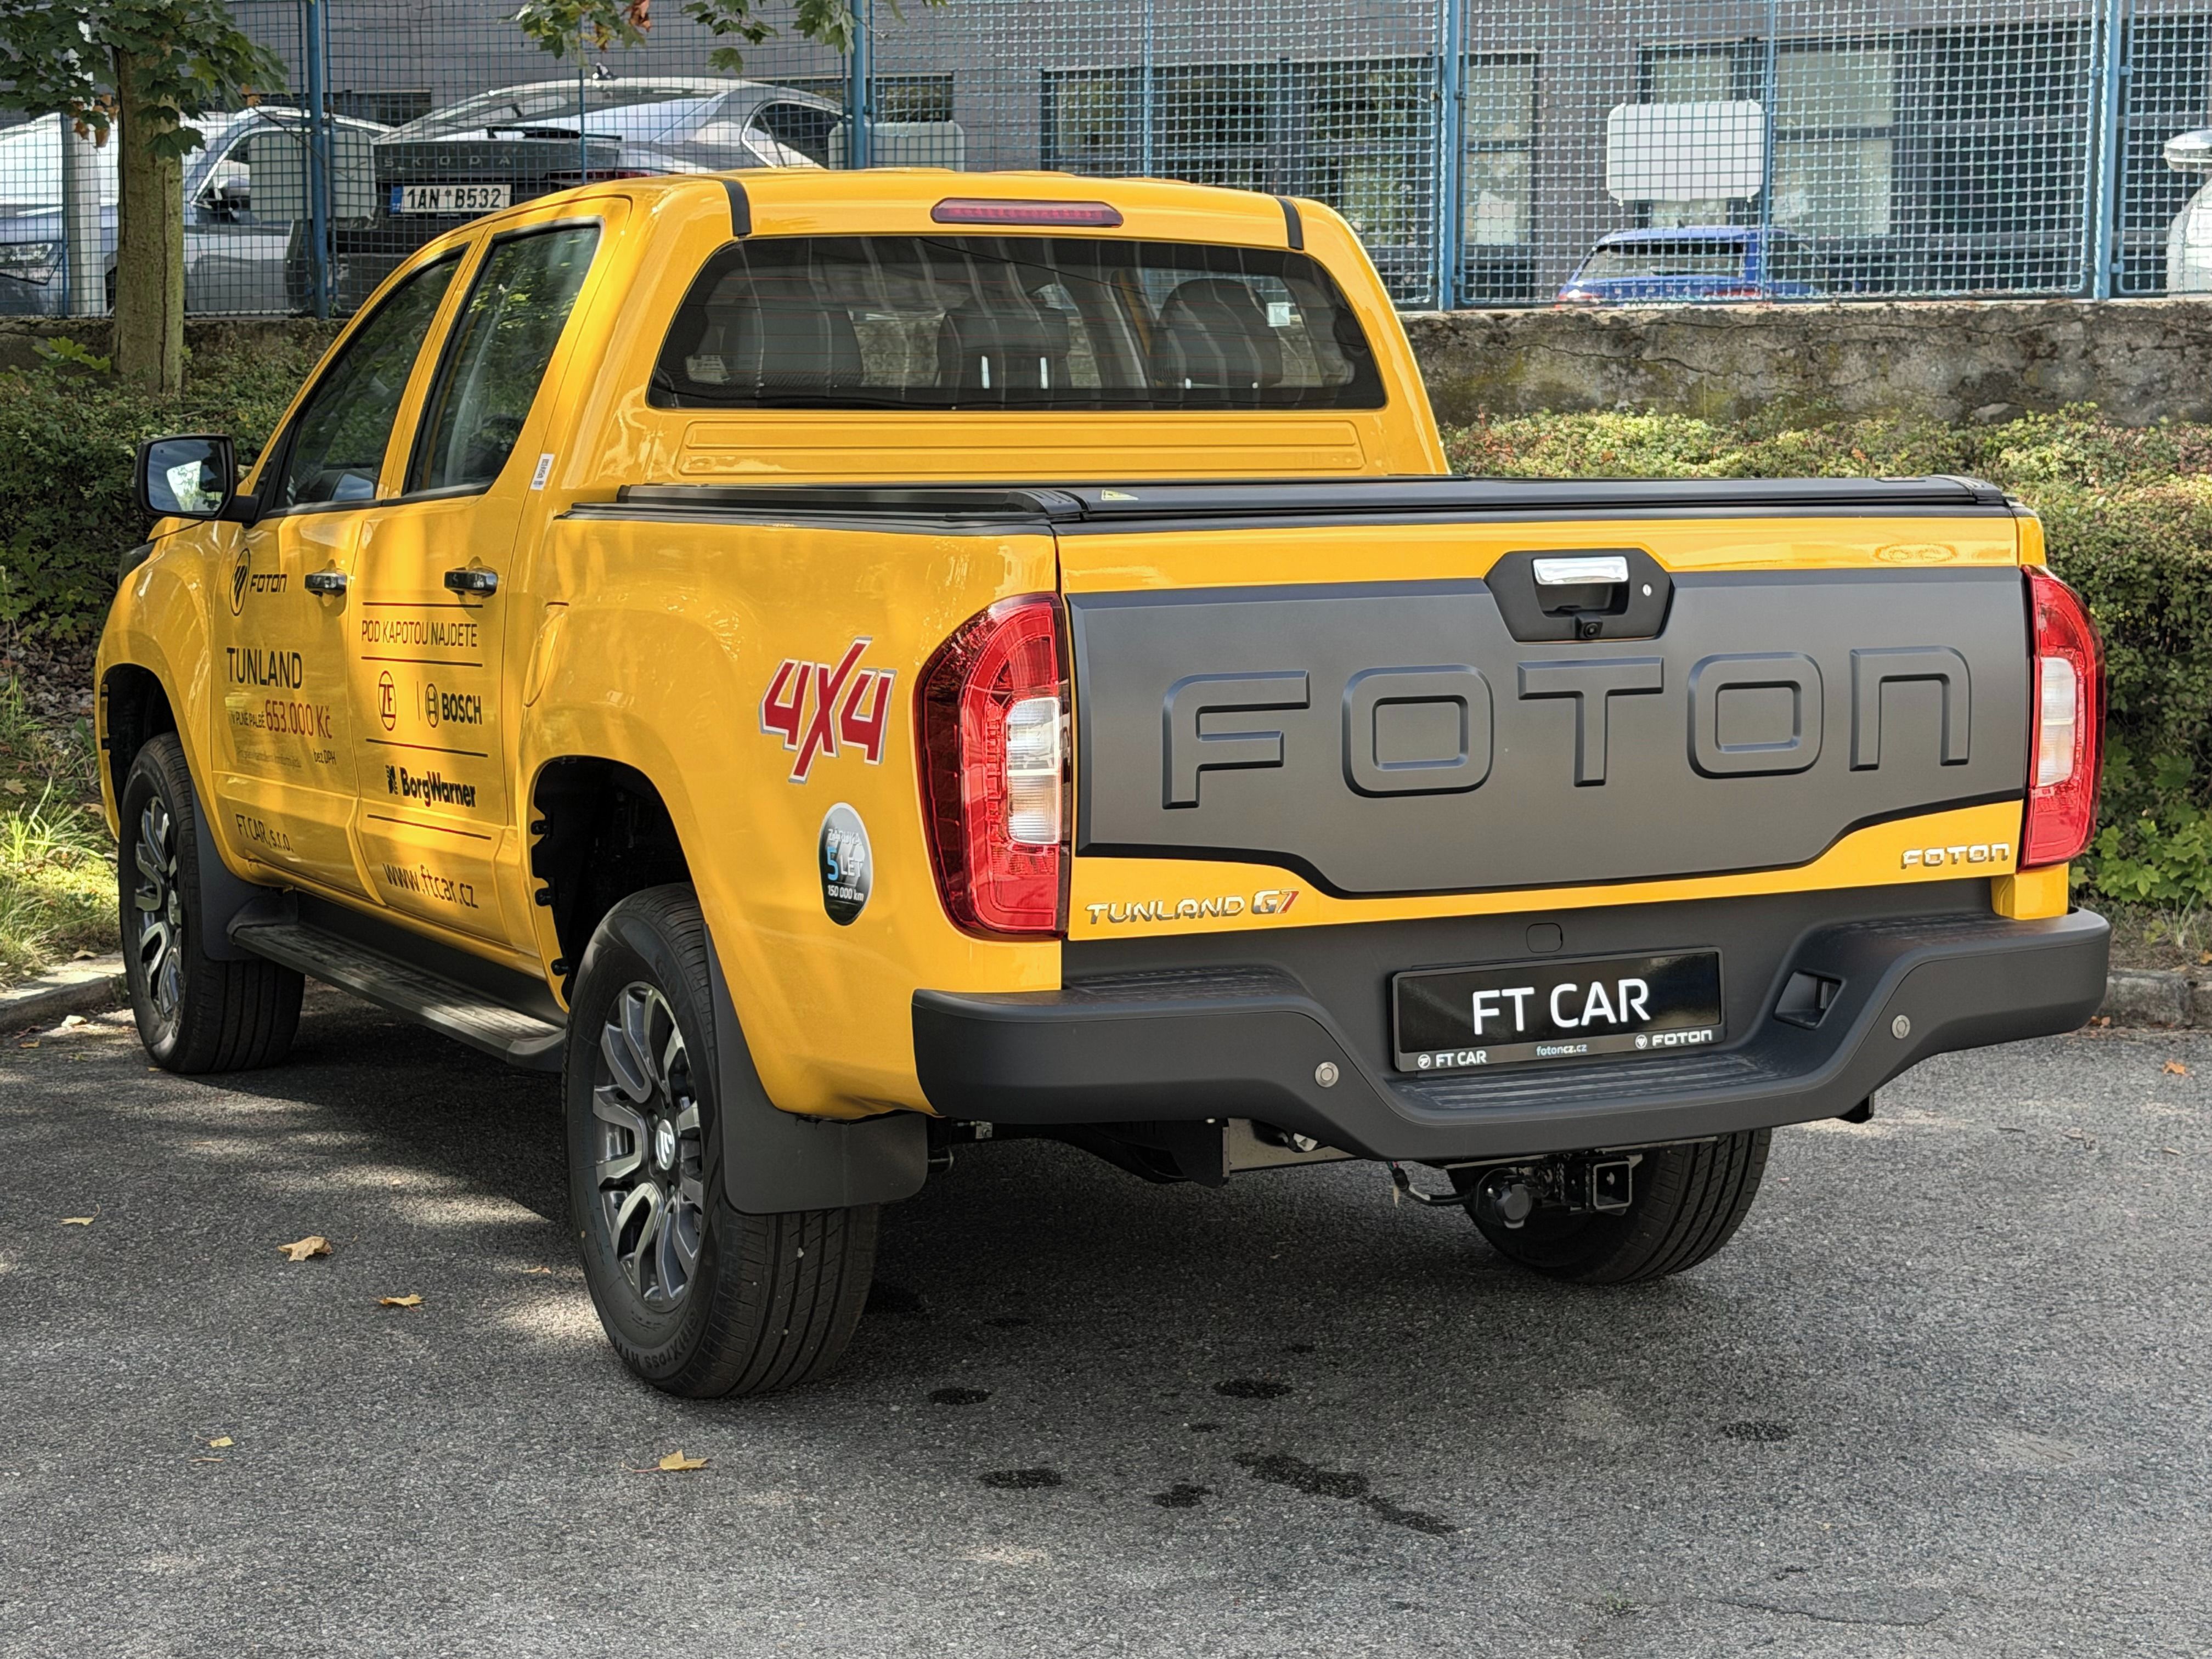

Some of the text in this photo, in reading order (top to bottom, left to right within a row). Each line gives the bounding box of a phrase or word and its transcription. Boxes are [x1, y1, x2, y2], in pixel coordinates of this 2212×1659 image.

[407, 188, 501, 209] 1AN B532
[249, 574, 287, 593] FOTON
[362, 619, 478, 647] POD KAPOTOU NAJDETE
[227, 647, 302, 689] TUNLAND
[379, 683, 396, 719] ZF
[442, 692, 482, 725] BOSCH
[265, 699, 314, 736] 653.000
[316, 704, 333, 739] Kč
[1163, 646, 1970, 809] FOTON
[399, 767, 476, 808] BorgWarner
[235, 814, 248, 838] FT
[269, 830, 295, 853] s.r.o.
[827, 846, 864, 881] 5 LET
[1900, 842, 2010, 869] FOTON
[383, 862, 479, 909] www.ftcar.cz
[828, 884, 865, 902] 150 000 km
[1085, 889, 1300, 924] TUNLAND G7
[1472, 978, 1651, 1035] FT CAR
[1536, 1043, 1587, 1057] fotoncz.cz
[1651, 1029, 1713, 1047] FOTON
[1435, 1050, 1487, 1068] FT CAR
